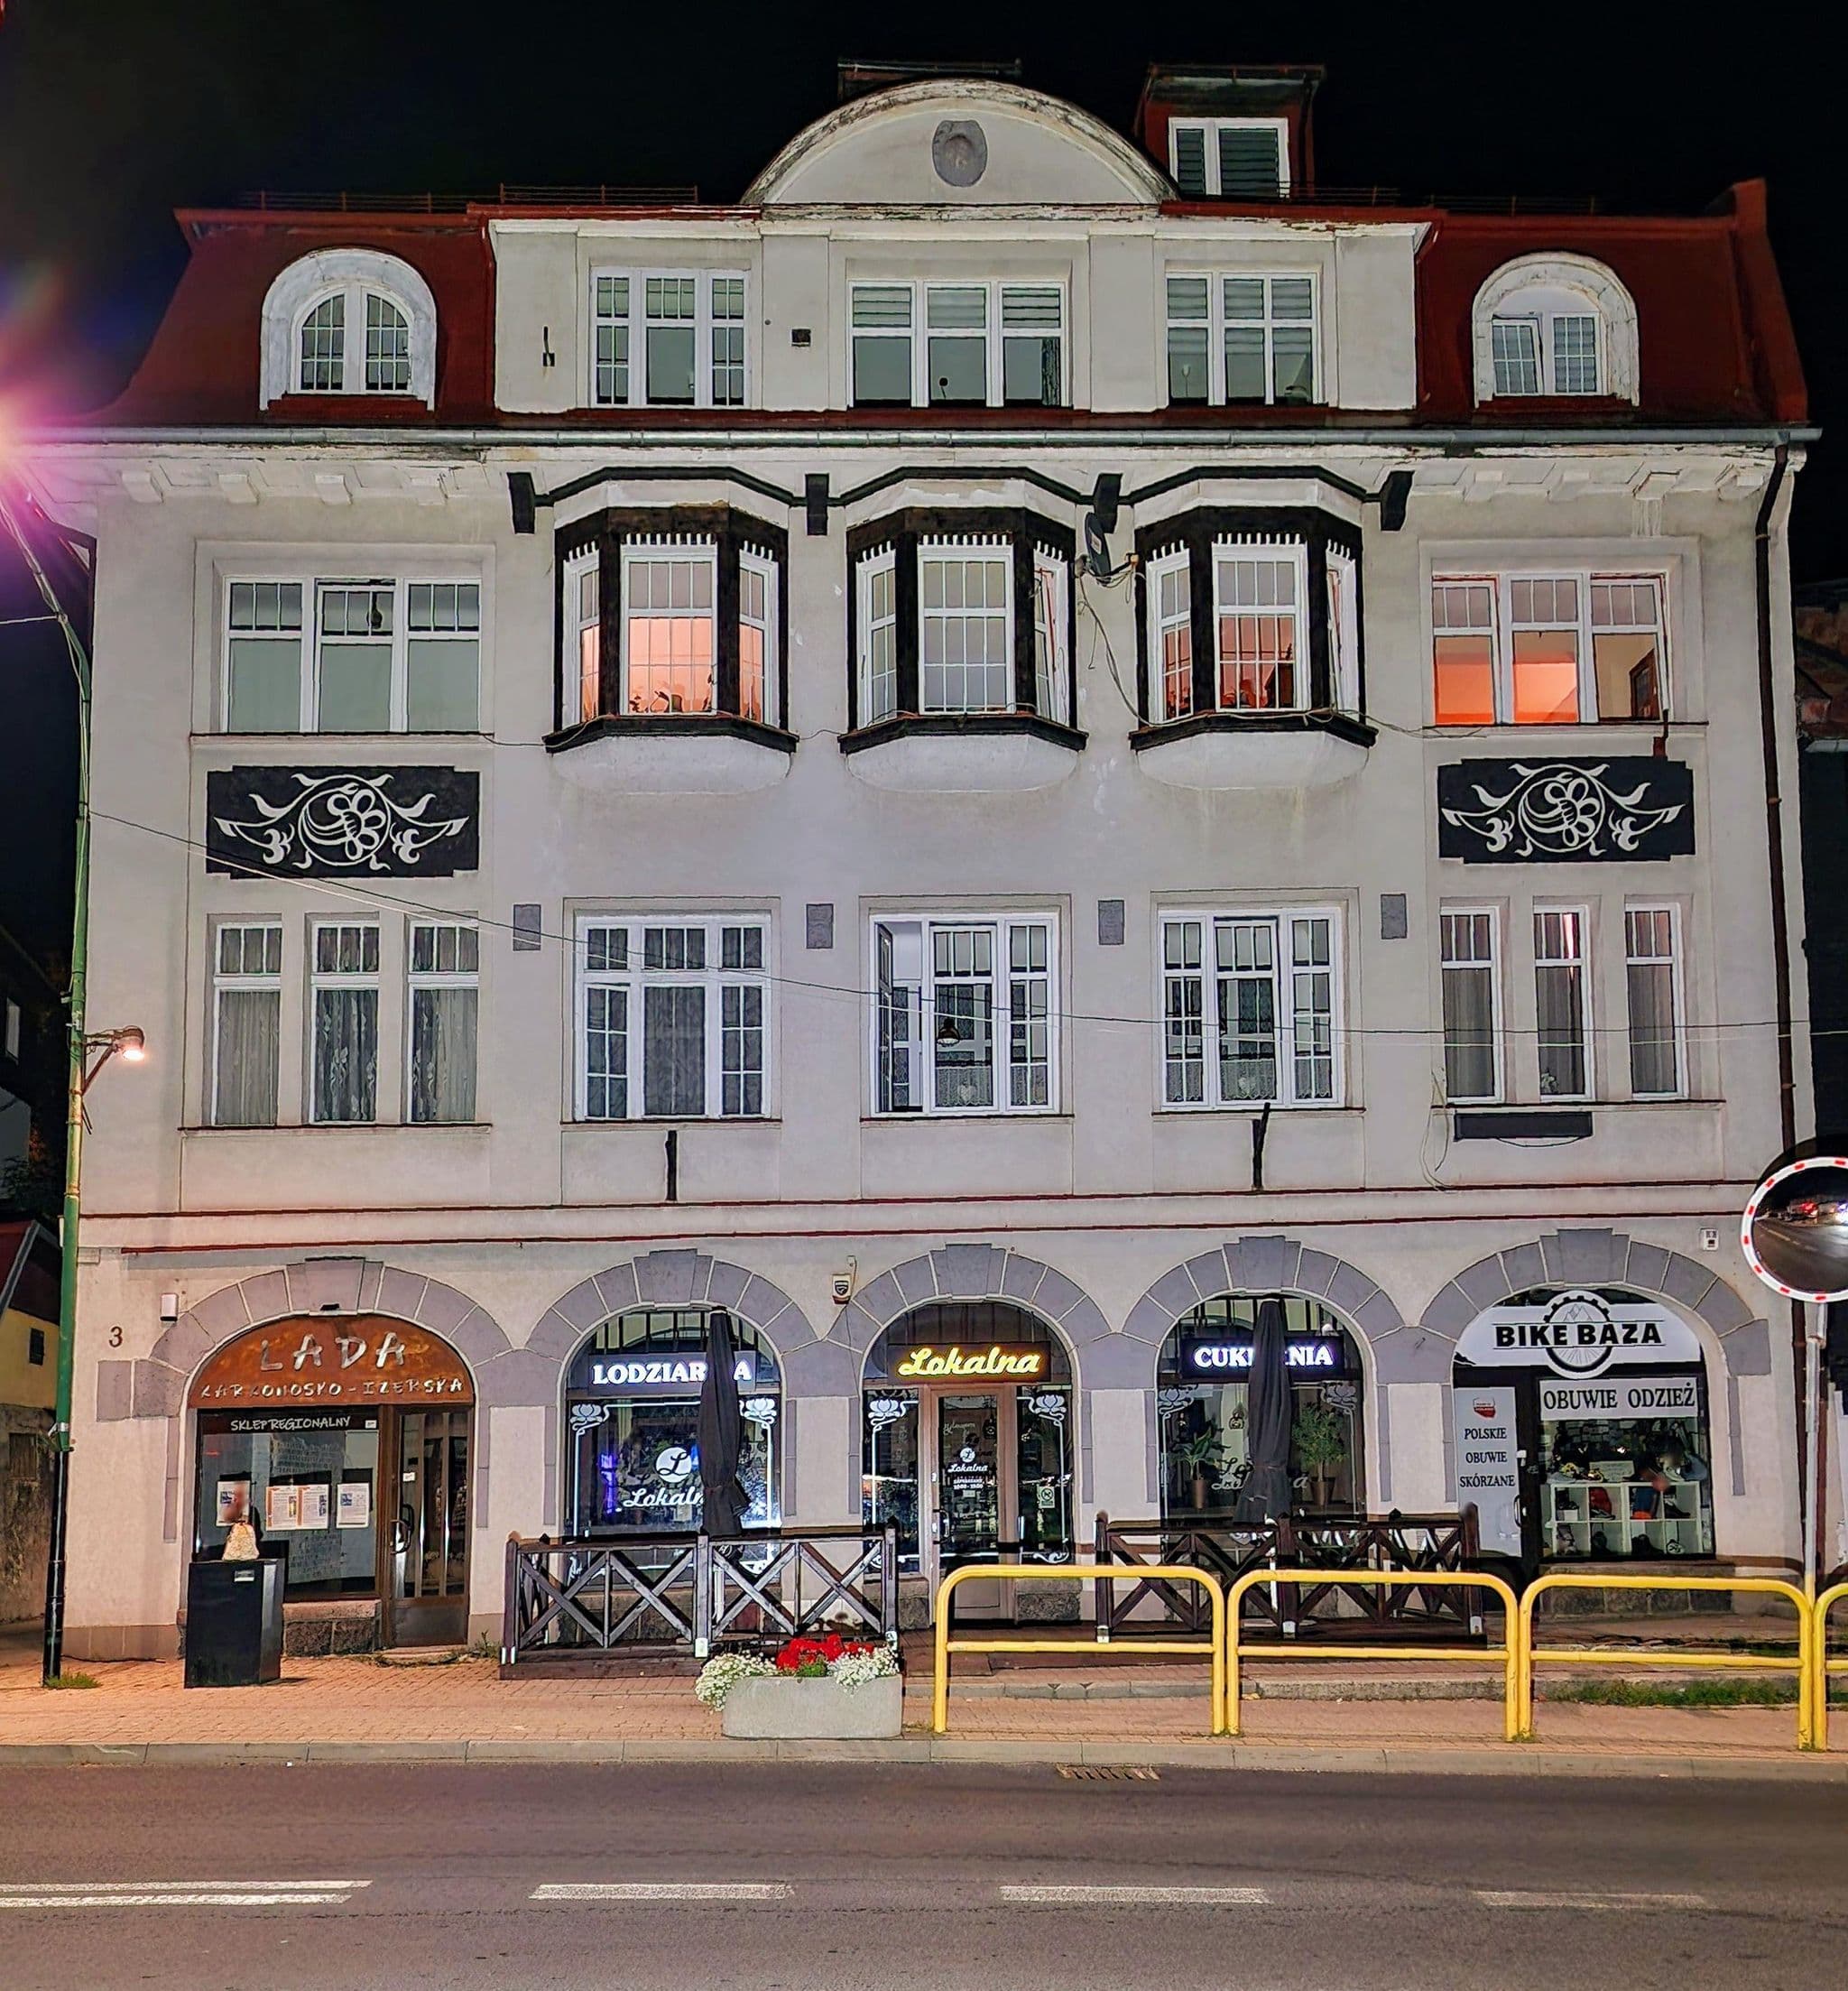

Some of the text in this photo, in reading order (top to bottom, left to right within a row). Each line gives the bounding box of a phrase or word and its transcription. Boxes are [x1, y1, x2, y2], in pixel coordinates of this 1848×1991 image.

[108, 1326, 123, 1347] 3
[1495, 1322, 1662, 1347] BIKE BAZA
[260, 1331, 406, 1372] LADA
[898, 1346, 1040, 1375] Lokalna
[1194, 1345, 1334, 1368] CUKINIA
[593, 1360, 752, 1384] LODZIARA
[1543, 1381, 1696, 1410] OBUWIE ODZIEŻ
[230, 1419, 268, 1431] SKLEP
[269, 1416, 351, 1431] REGIONALNY
[1464, 1427, 1508, 1440] POLSKIE
[1465, 1450, 1508, 1463] OBUWIE
[947, 1463, 989, 1473] Lokalna
[1459, 1473, 1516, 1487] SKÓRZANE
[623, 1486, 704, 1508] Lokaln
